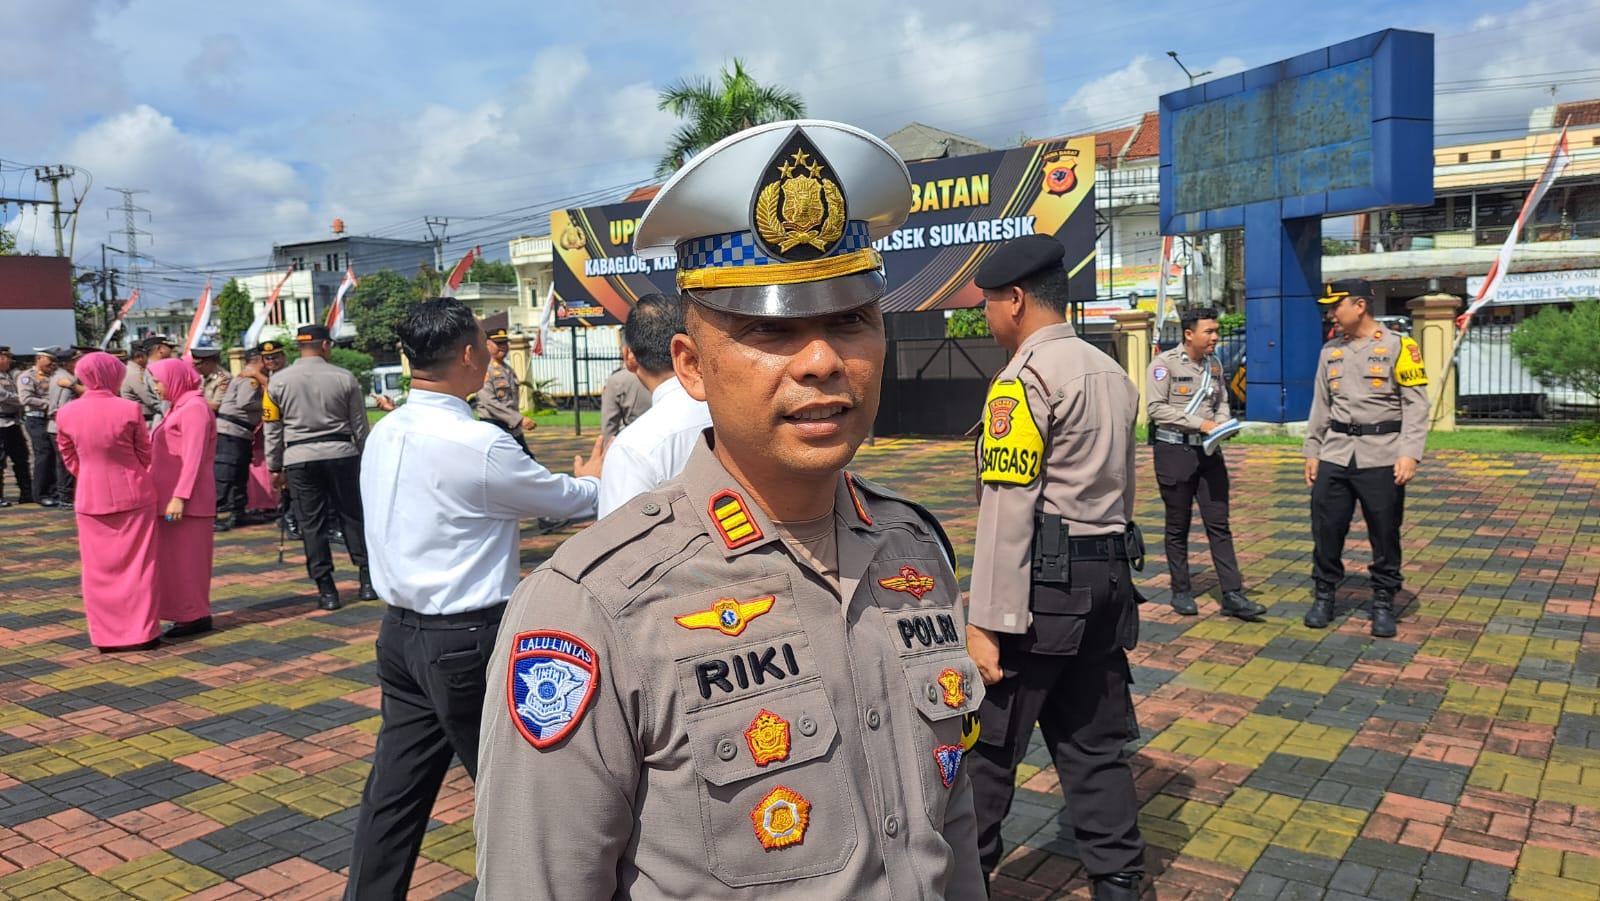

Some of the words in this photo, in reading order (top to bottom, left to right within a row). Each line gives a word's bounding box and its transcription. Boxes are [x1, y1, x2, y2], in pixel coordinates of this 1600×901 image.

[929, 215, 1036, 247] SUKARESIK
[1496, 288, 1551, 300] MAMIH
[897, 613, 958, 649] POLRI
[520, 637, 550, 652] LALU
[552, 640, 592, 663] LINTAS
[695, 642, 800, 700] RIKI
